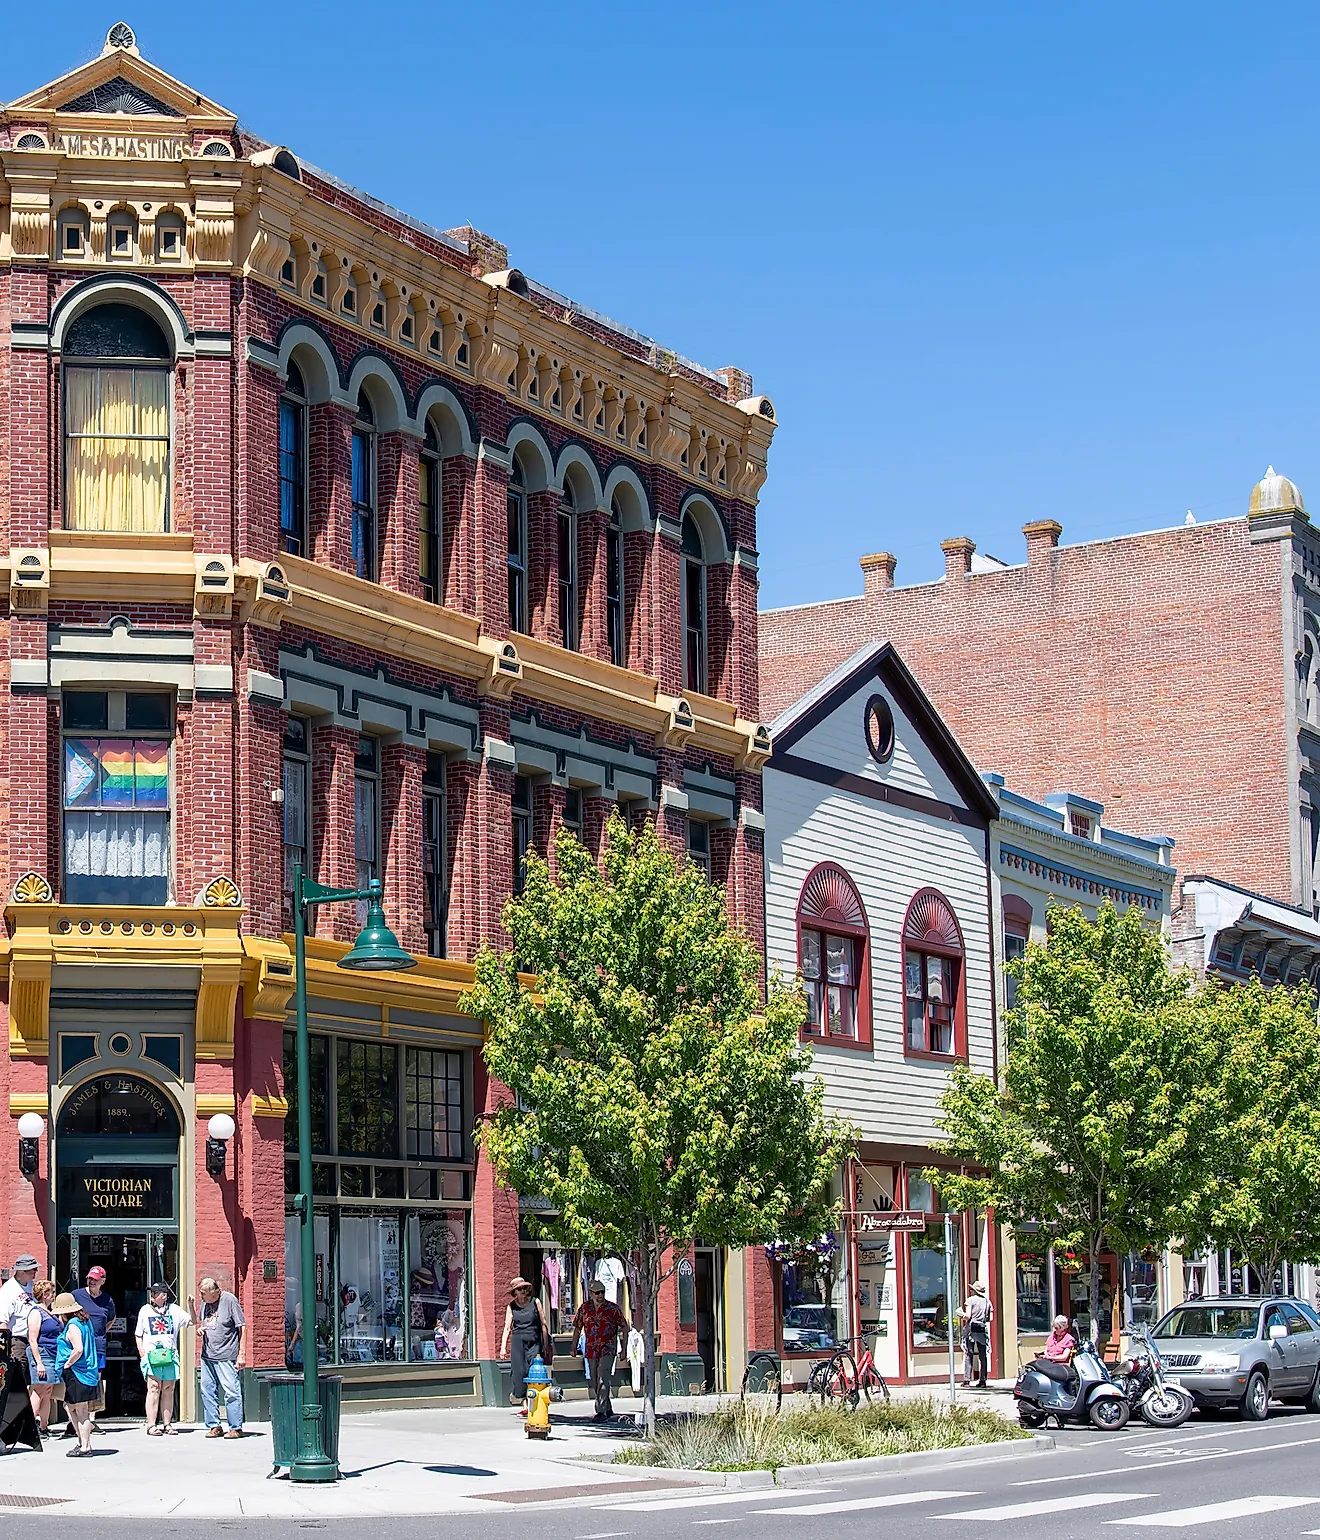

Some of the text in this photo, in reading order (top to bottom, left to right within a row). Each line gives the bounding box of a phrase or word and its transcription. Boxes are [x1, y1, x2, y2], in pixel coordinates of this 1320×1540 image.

[68, 1085, 99, 1116] JAMES
[104, 1080, 112, 1090] &
[83, 1178, 152, 1192] VICTORIAN
[92, 1194, 143, 1208] SQUARE
